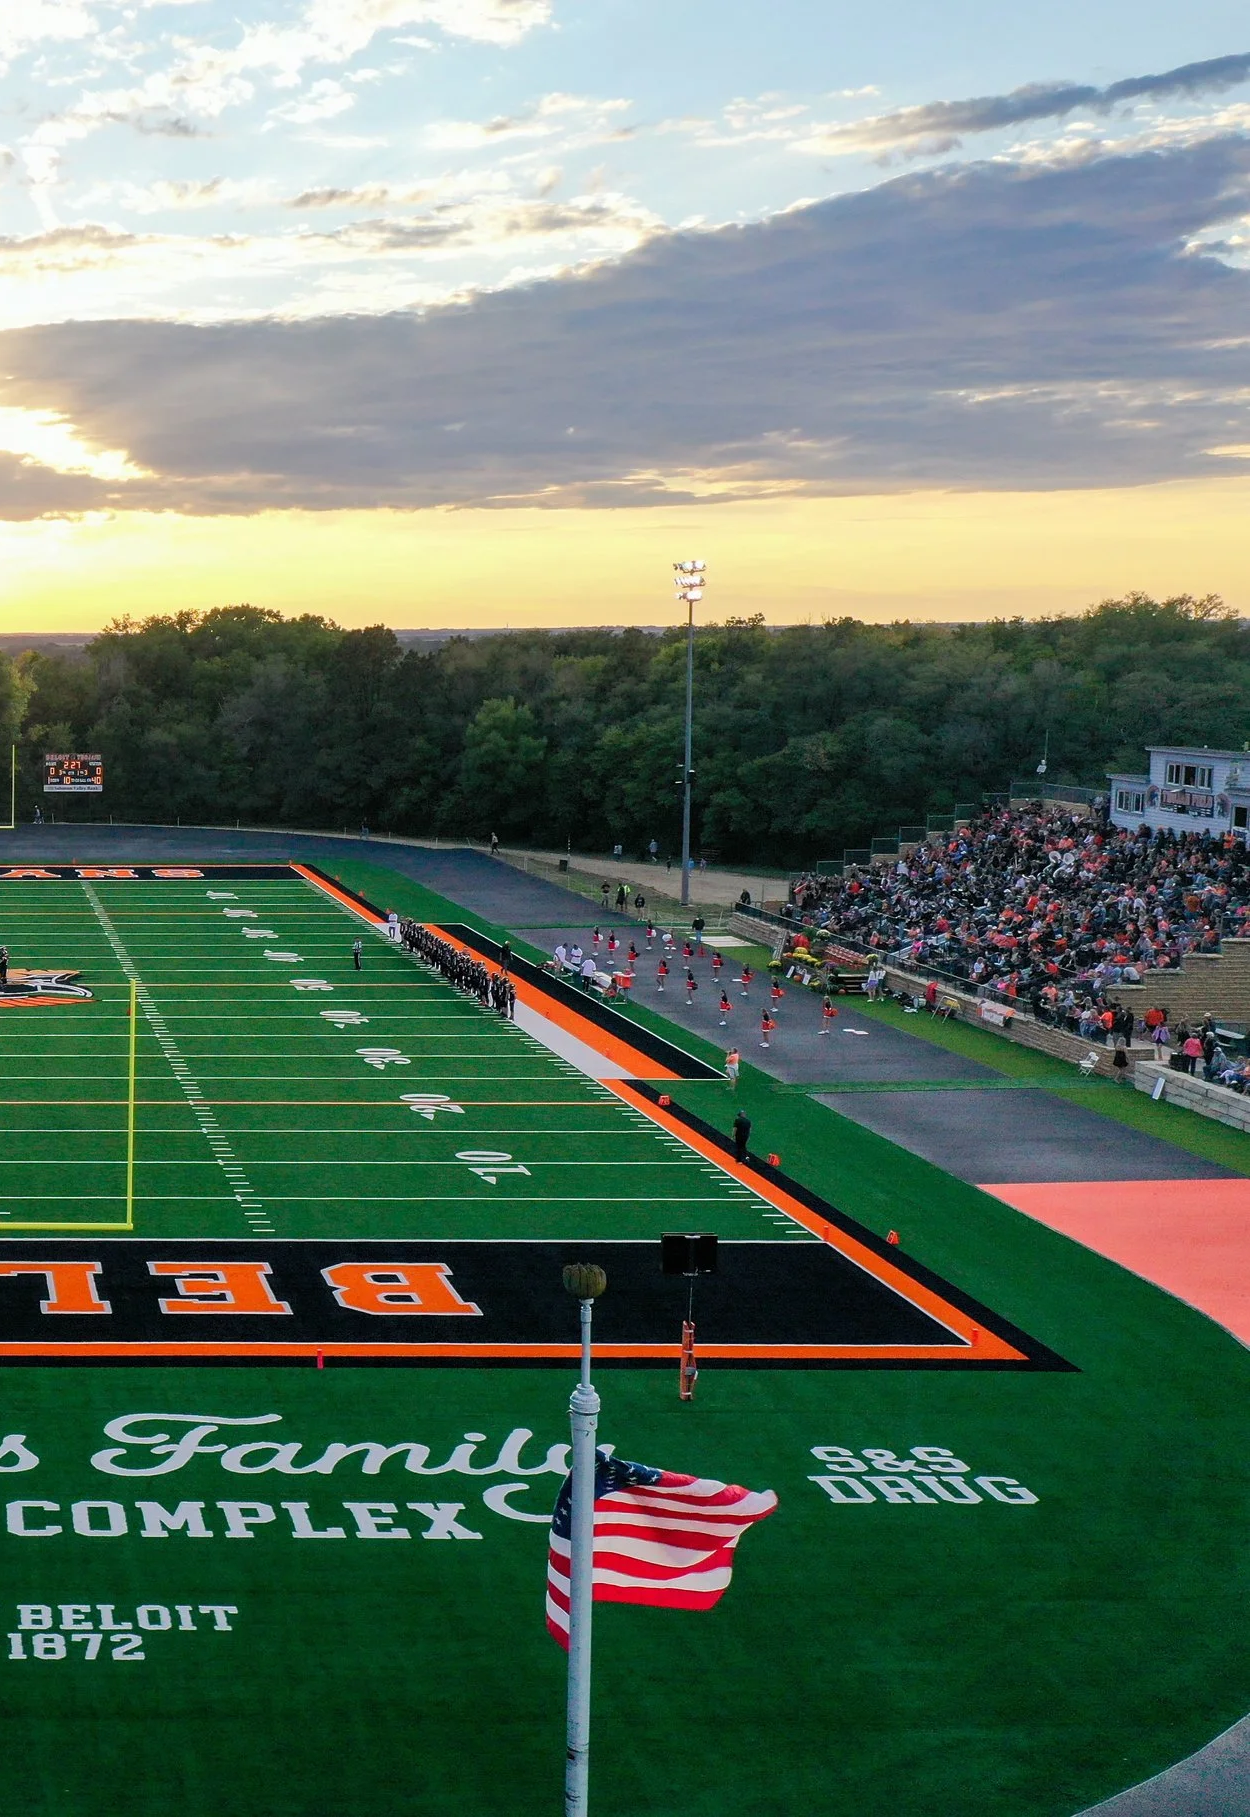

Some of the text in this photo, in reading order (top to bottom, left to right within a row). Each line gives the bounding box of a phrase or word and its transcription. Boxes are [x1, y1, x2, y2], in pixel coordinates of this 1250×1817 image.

[455, 1150, 532, 1176] 10
[809, 1446, 971, 1473] S&S
[806, 1475, 1040, 1505] DRUG
[6, 1500, 483, 1539] COMPLEX
[16, 1604, 238, 1631] BELOIT
[7, 1632, 146, 1661] 1872
